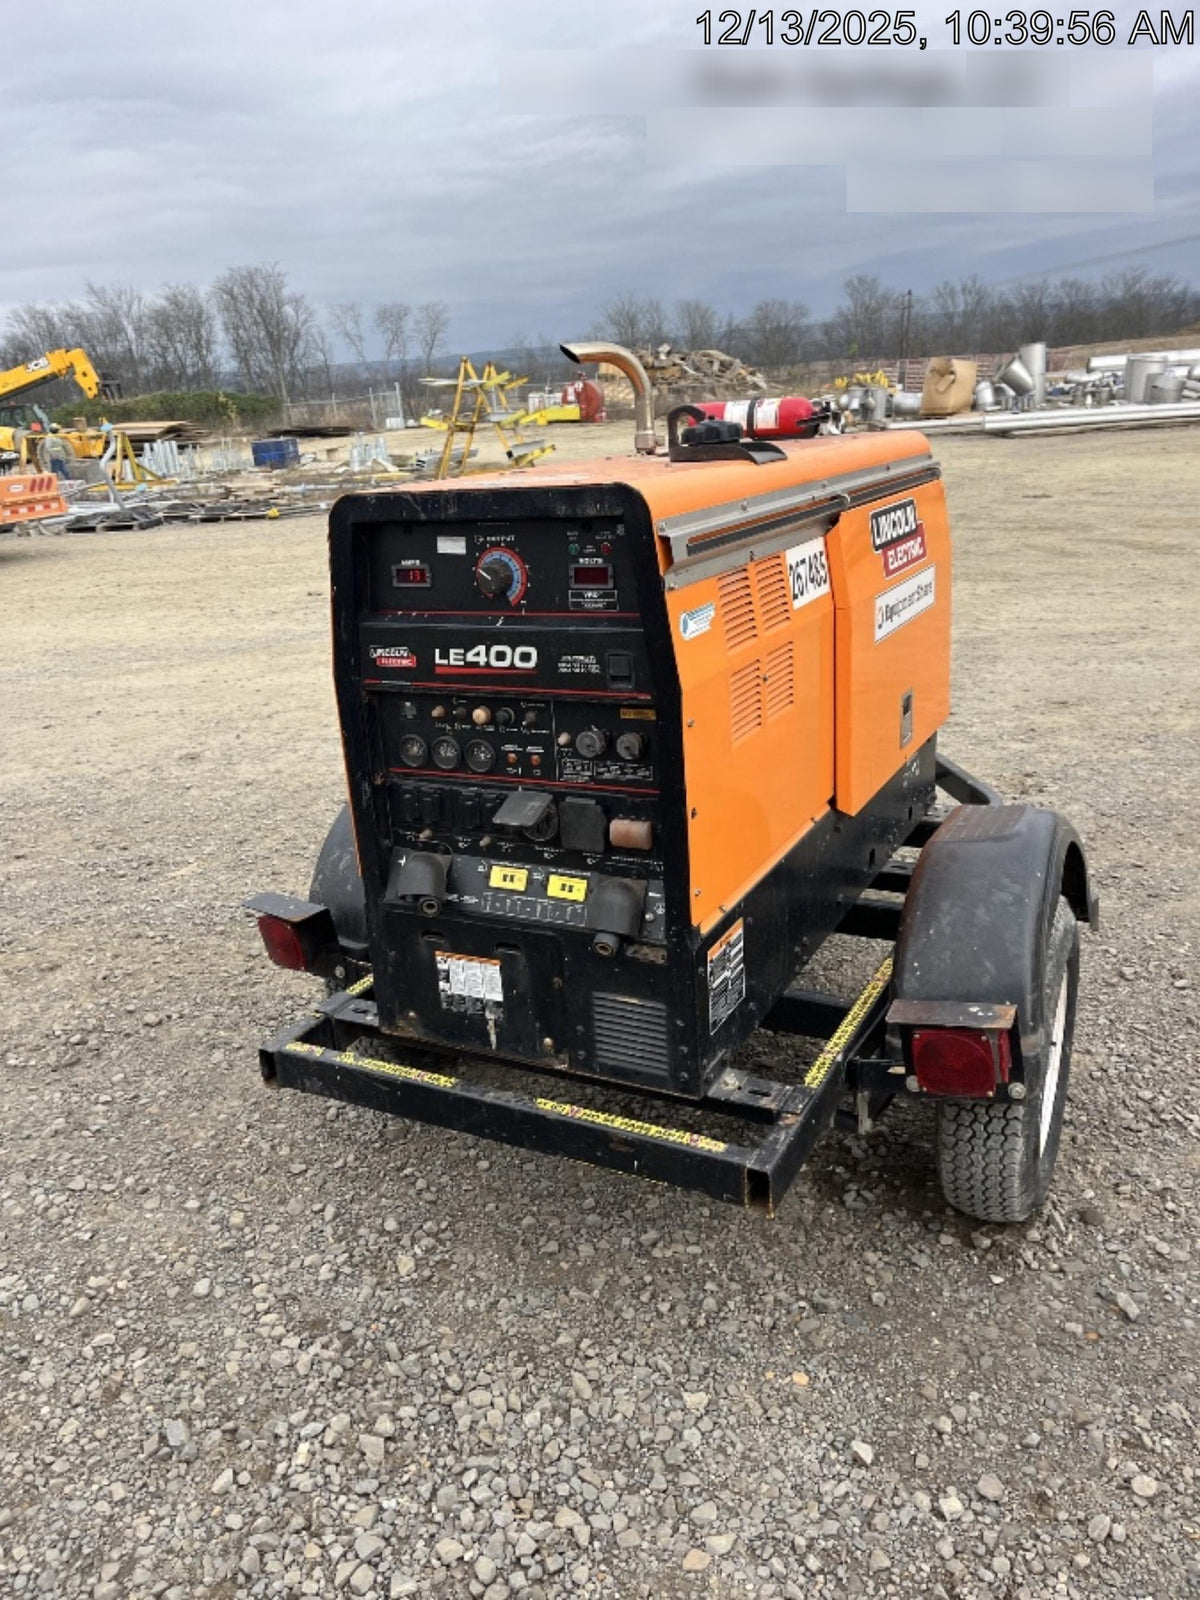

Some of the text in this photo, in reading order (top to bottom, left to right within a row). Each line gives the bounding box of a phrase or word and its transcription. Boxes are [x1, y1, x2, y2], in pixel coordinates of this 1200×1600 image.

[872, 504, 916, 546] LINCOLN
[887, 536, 924, 571] ELECTRIC
[788, 551, 827, 601] 267485
[435, 645, 538, 669] LE400
